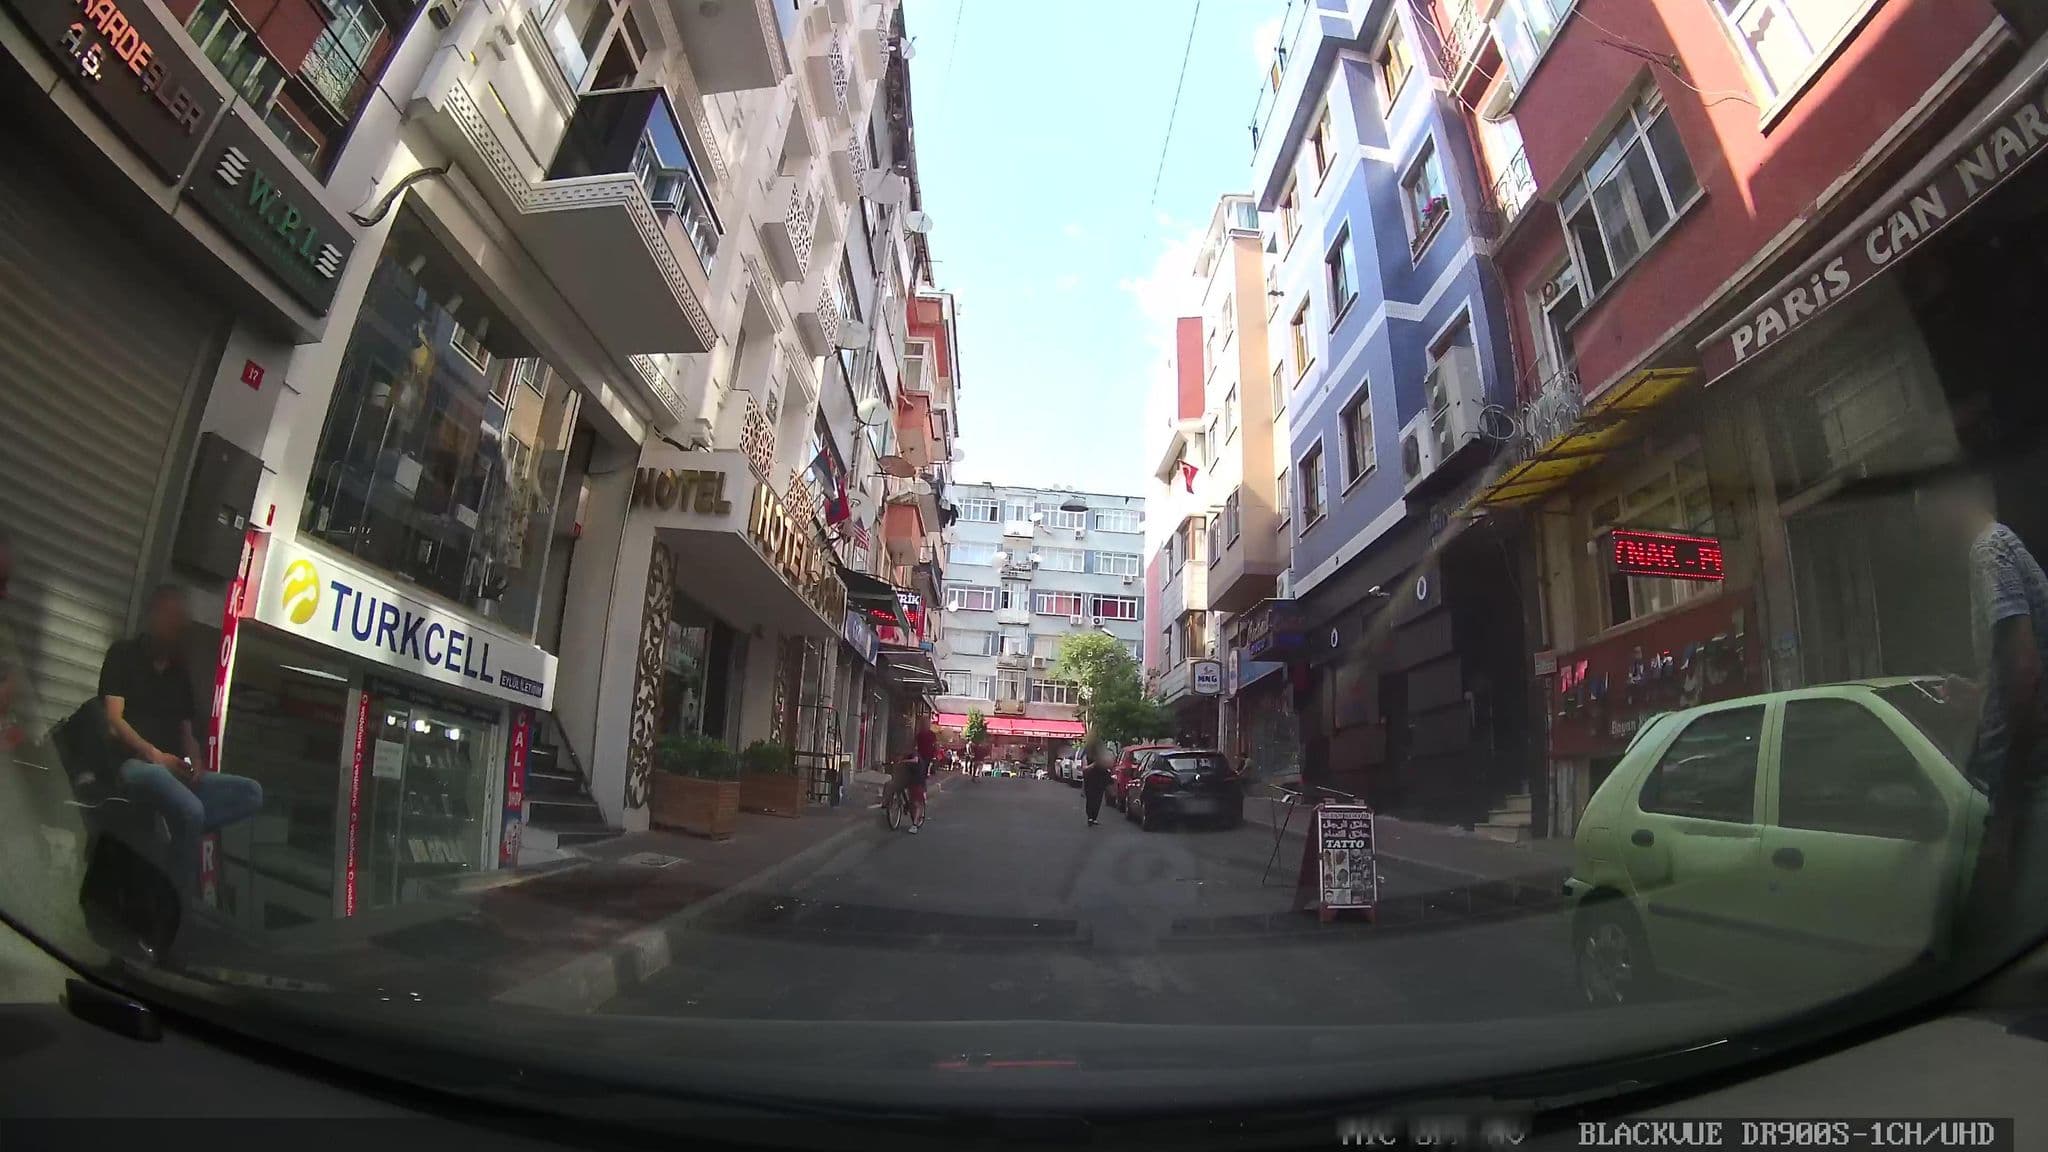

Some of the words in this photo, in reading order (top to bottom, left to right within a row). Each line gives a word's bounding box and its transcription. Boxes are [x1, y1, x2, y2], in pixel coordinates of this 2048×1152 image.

[1866, 184, 1947, 265] CAN
[1955, 86, 2048, 199] NAR
[632, 467, 731, 514] HOTEL
[331, 580, 494, 683] TURKCELL
[1326, 840, 1364, 848] TATTO
